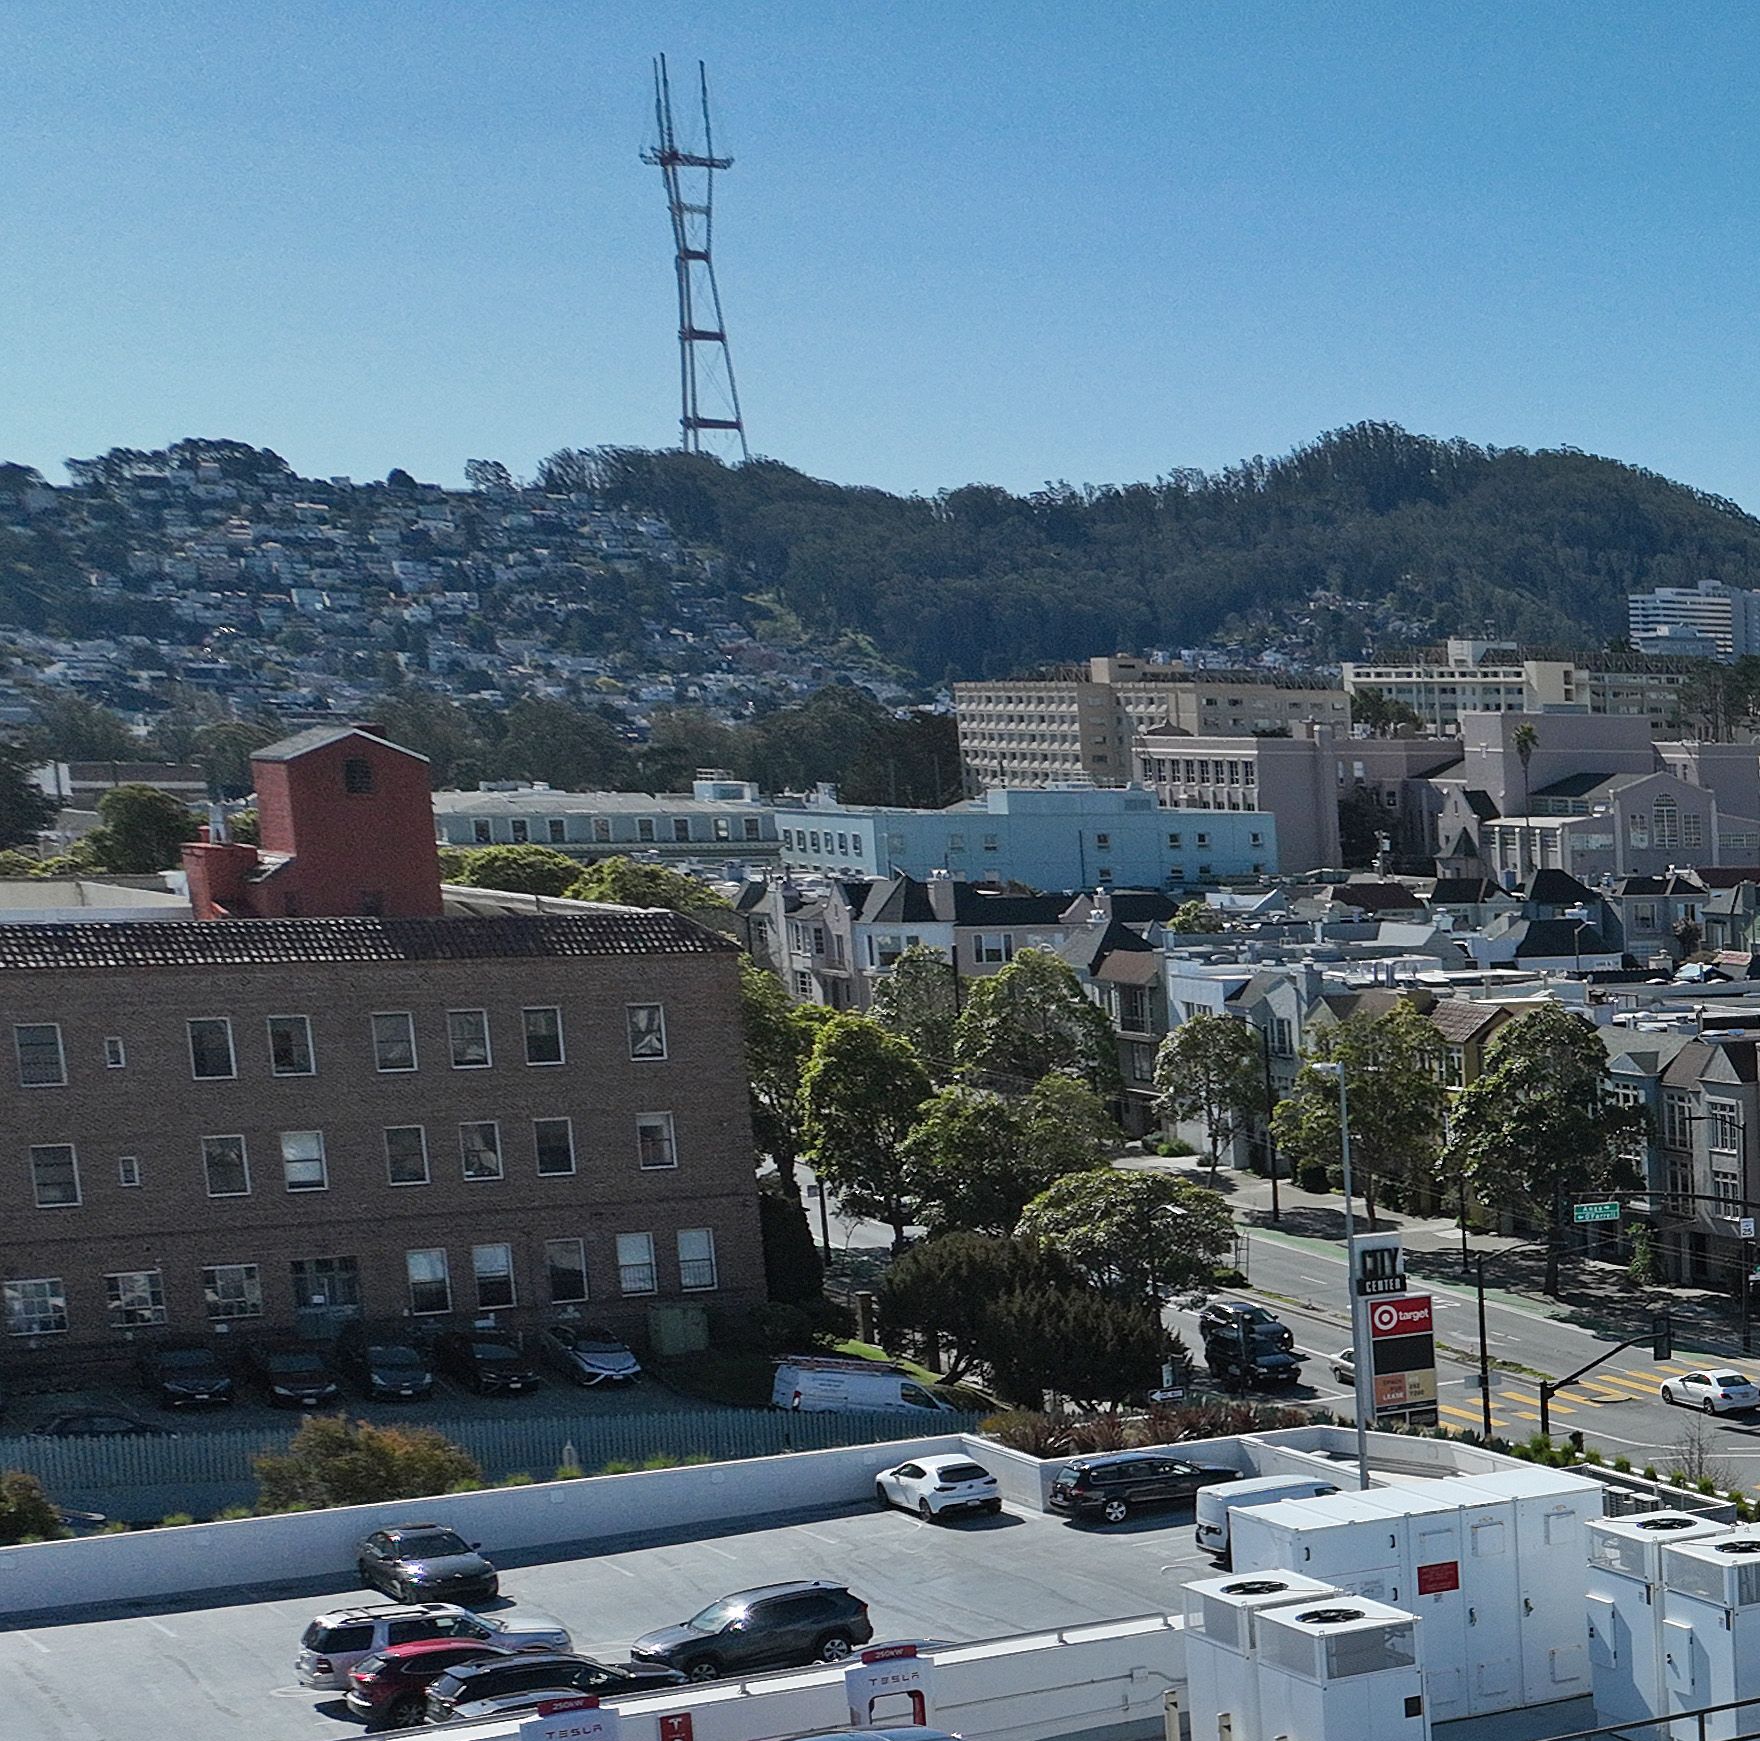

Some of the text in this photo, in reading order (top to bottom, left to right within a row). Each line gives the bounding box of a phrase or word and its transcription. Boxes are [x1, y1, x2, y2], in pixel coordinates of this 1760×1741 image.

[1742, 1228, 1752, 1236] 25
[1362, 1248, 1400, 1278] CITY
[1365, 1278, 1401, 1293] CENTER
[1398, 1308, 1430, 1322] target
[868, 1672, 920, 1686] TESLA
[545, 1724, 603, 1740] TESLA
